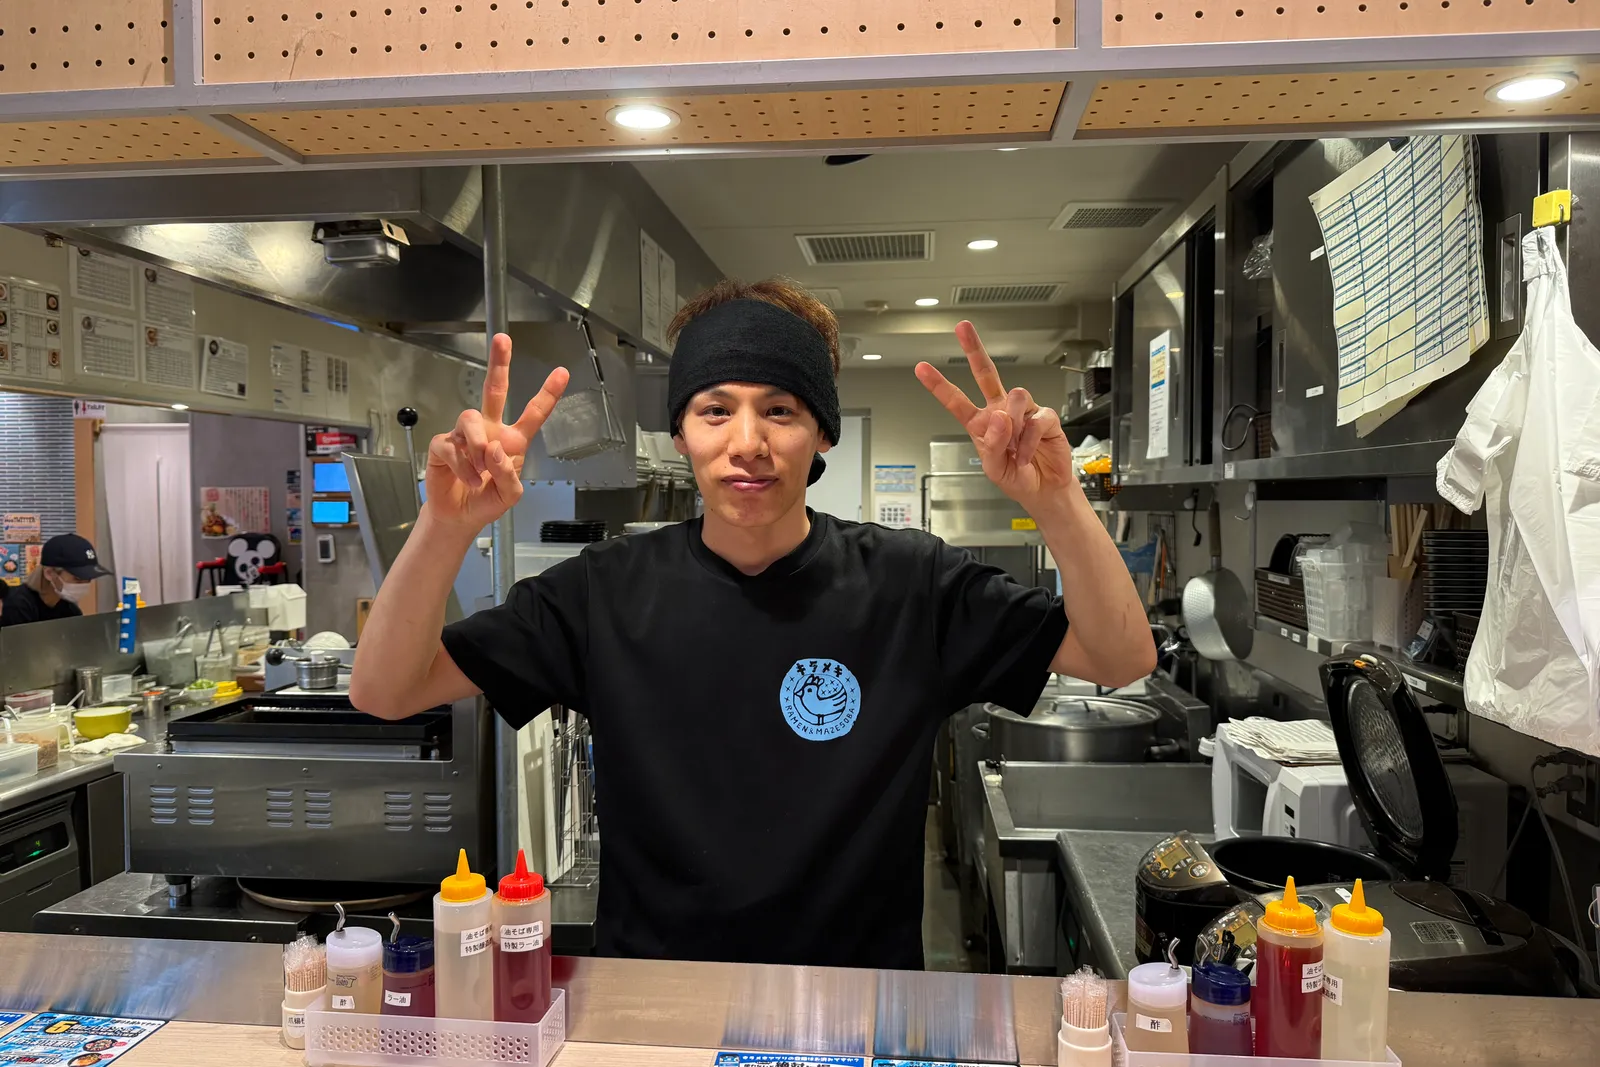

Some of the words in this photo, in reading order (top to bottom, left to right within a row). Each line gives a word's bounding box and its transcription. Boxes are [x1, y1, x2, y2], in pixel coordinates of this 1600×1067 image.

[796, 660, 843, 678] キラメキ
[504, 925, 539, 936] 油そば専用
[504, 940, 539, 950] 特製ラー油
[388, 994, 407, 1004] ラー油
[1150, 1019, 1160, 1030] 酢
